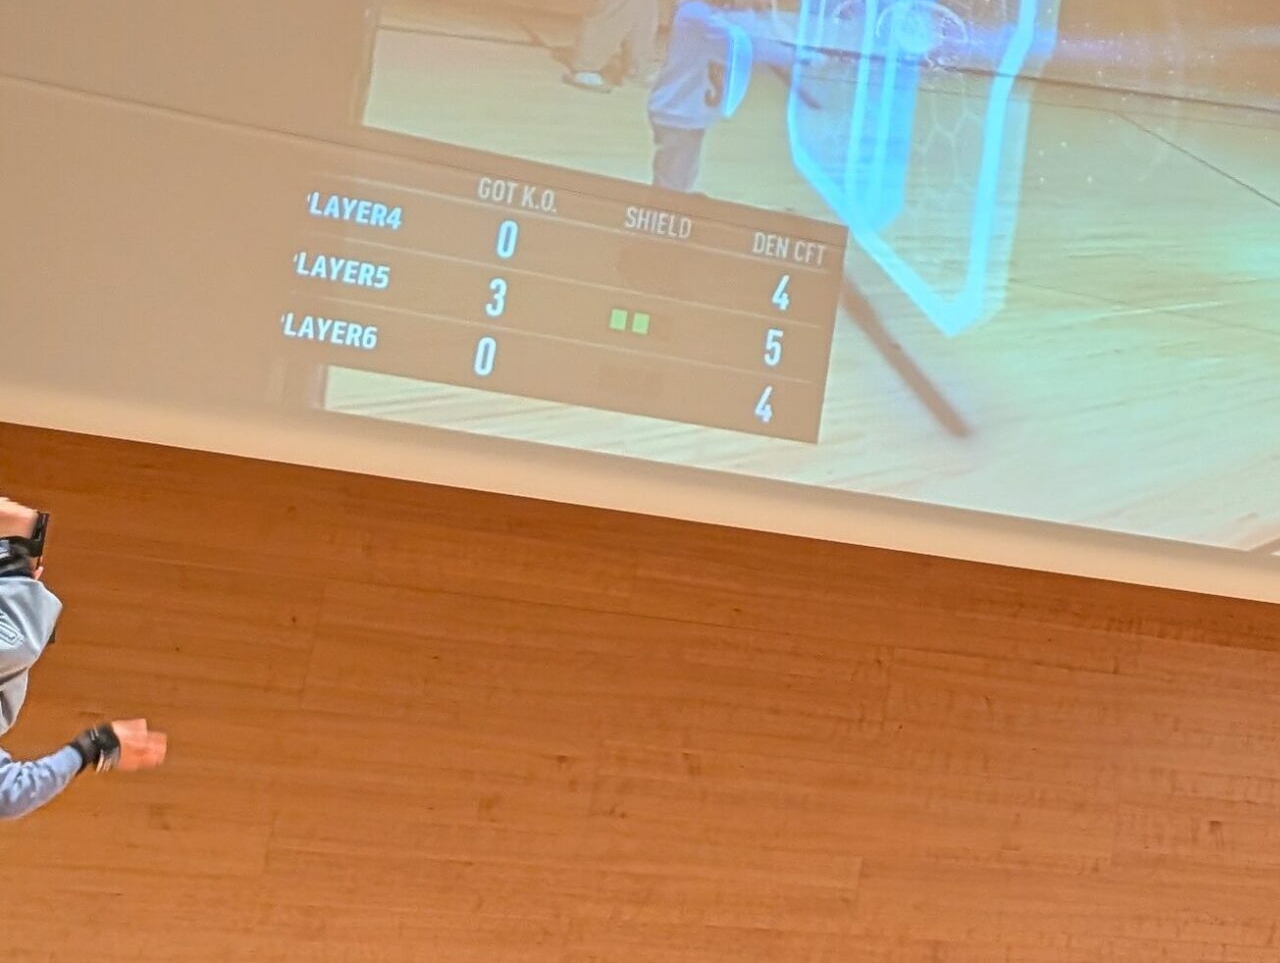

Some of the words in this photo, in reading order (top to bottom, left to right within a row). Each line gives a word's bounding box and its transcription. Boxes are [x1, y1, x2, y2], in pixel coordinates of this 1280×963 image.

[478, 177, 518, 204] GOT
[521, 186, 557, 213] K.O.
[625, 206, 692, 239] SHIELD
[308, 192, 402, 229] LAYER4
[772, 274, 790, 311] 4
[294, 252, 390, 288] LAYER5
[485, 278, 507, 318] 3
[764, 328, 784, 367] 5
[281, 312, 378, 349] LAYER6
[755, 385, 773, 423] 4
